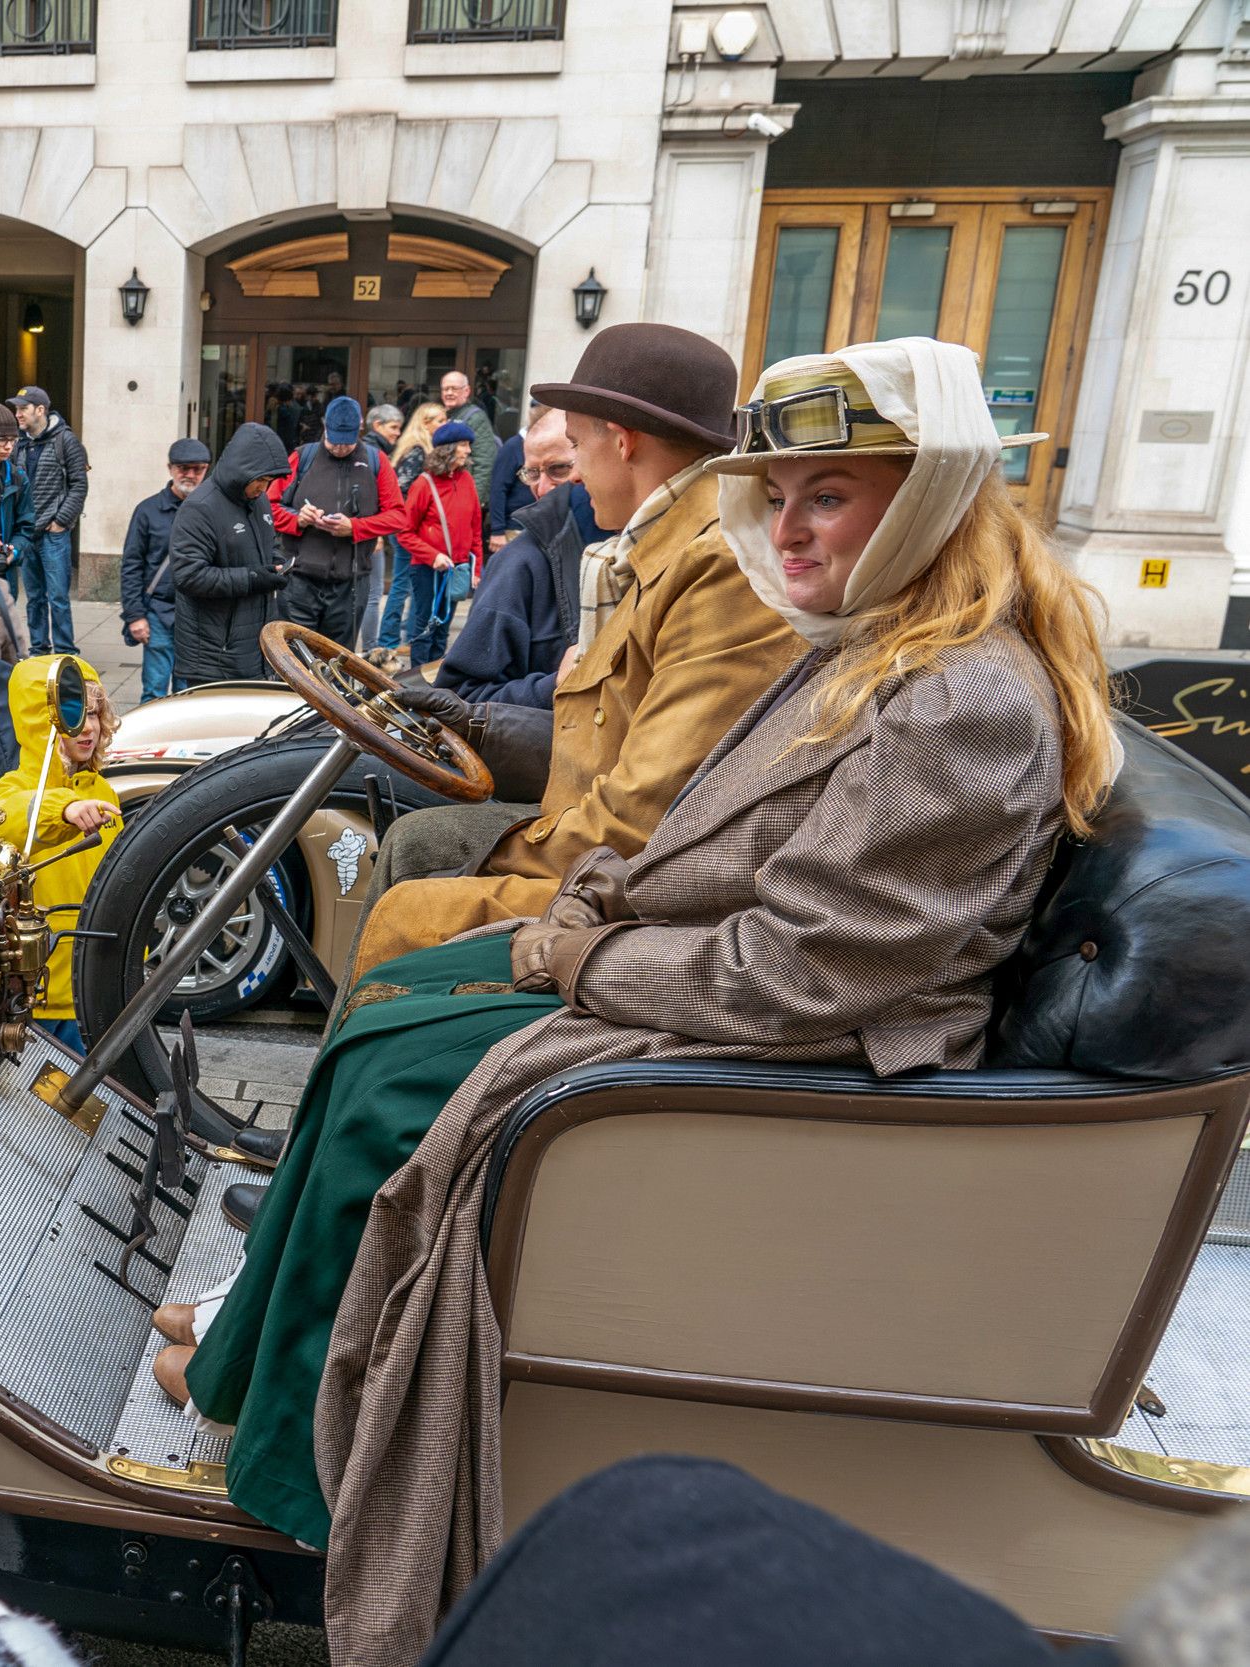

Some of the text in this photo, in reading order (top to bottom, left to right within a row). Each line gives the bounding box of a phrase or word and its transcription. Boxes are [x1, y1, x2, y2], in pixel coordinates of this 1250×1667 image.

[358, 280, 376, 296] 52
[1173, 269, 1231, 306] 50
[1143, 562, 1167, 585] H
[151, 765, 261, 842] DUNLOP
[265, 942, 278, 966] SPORT
